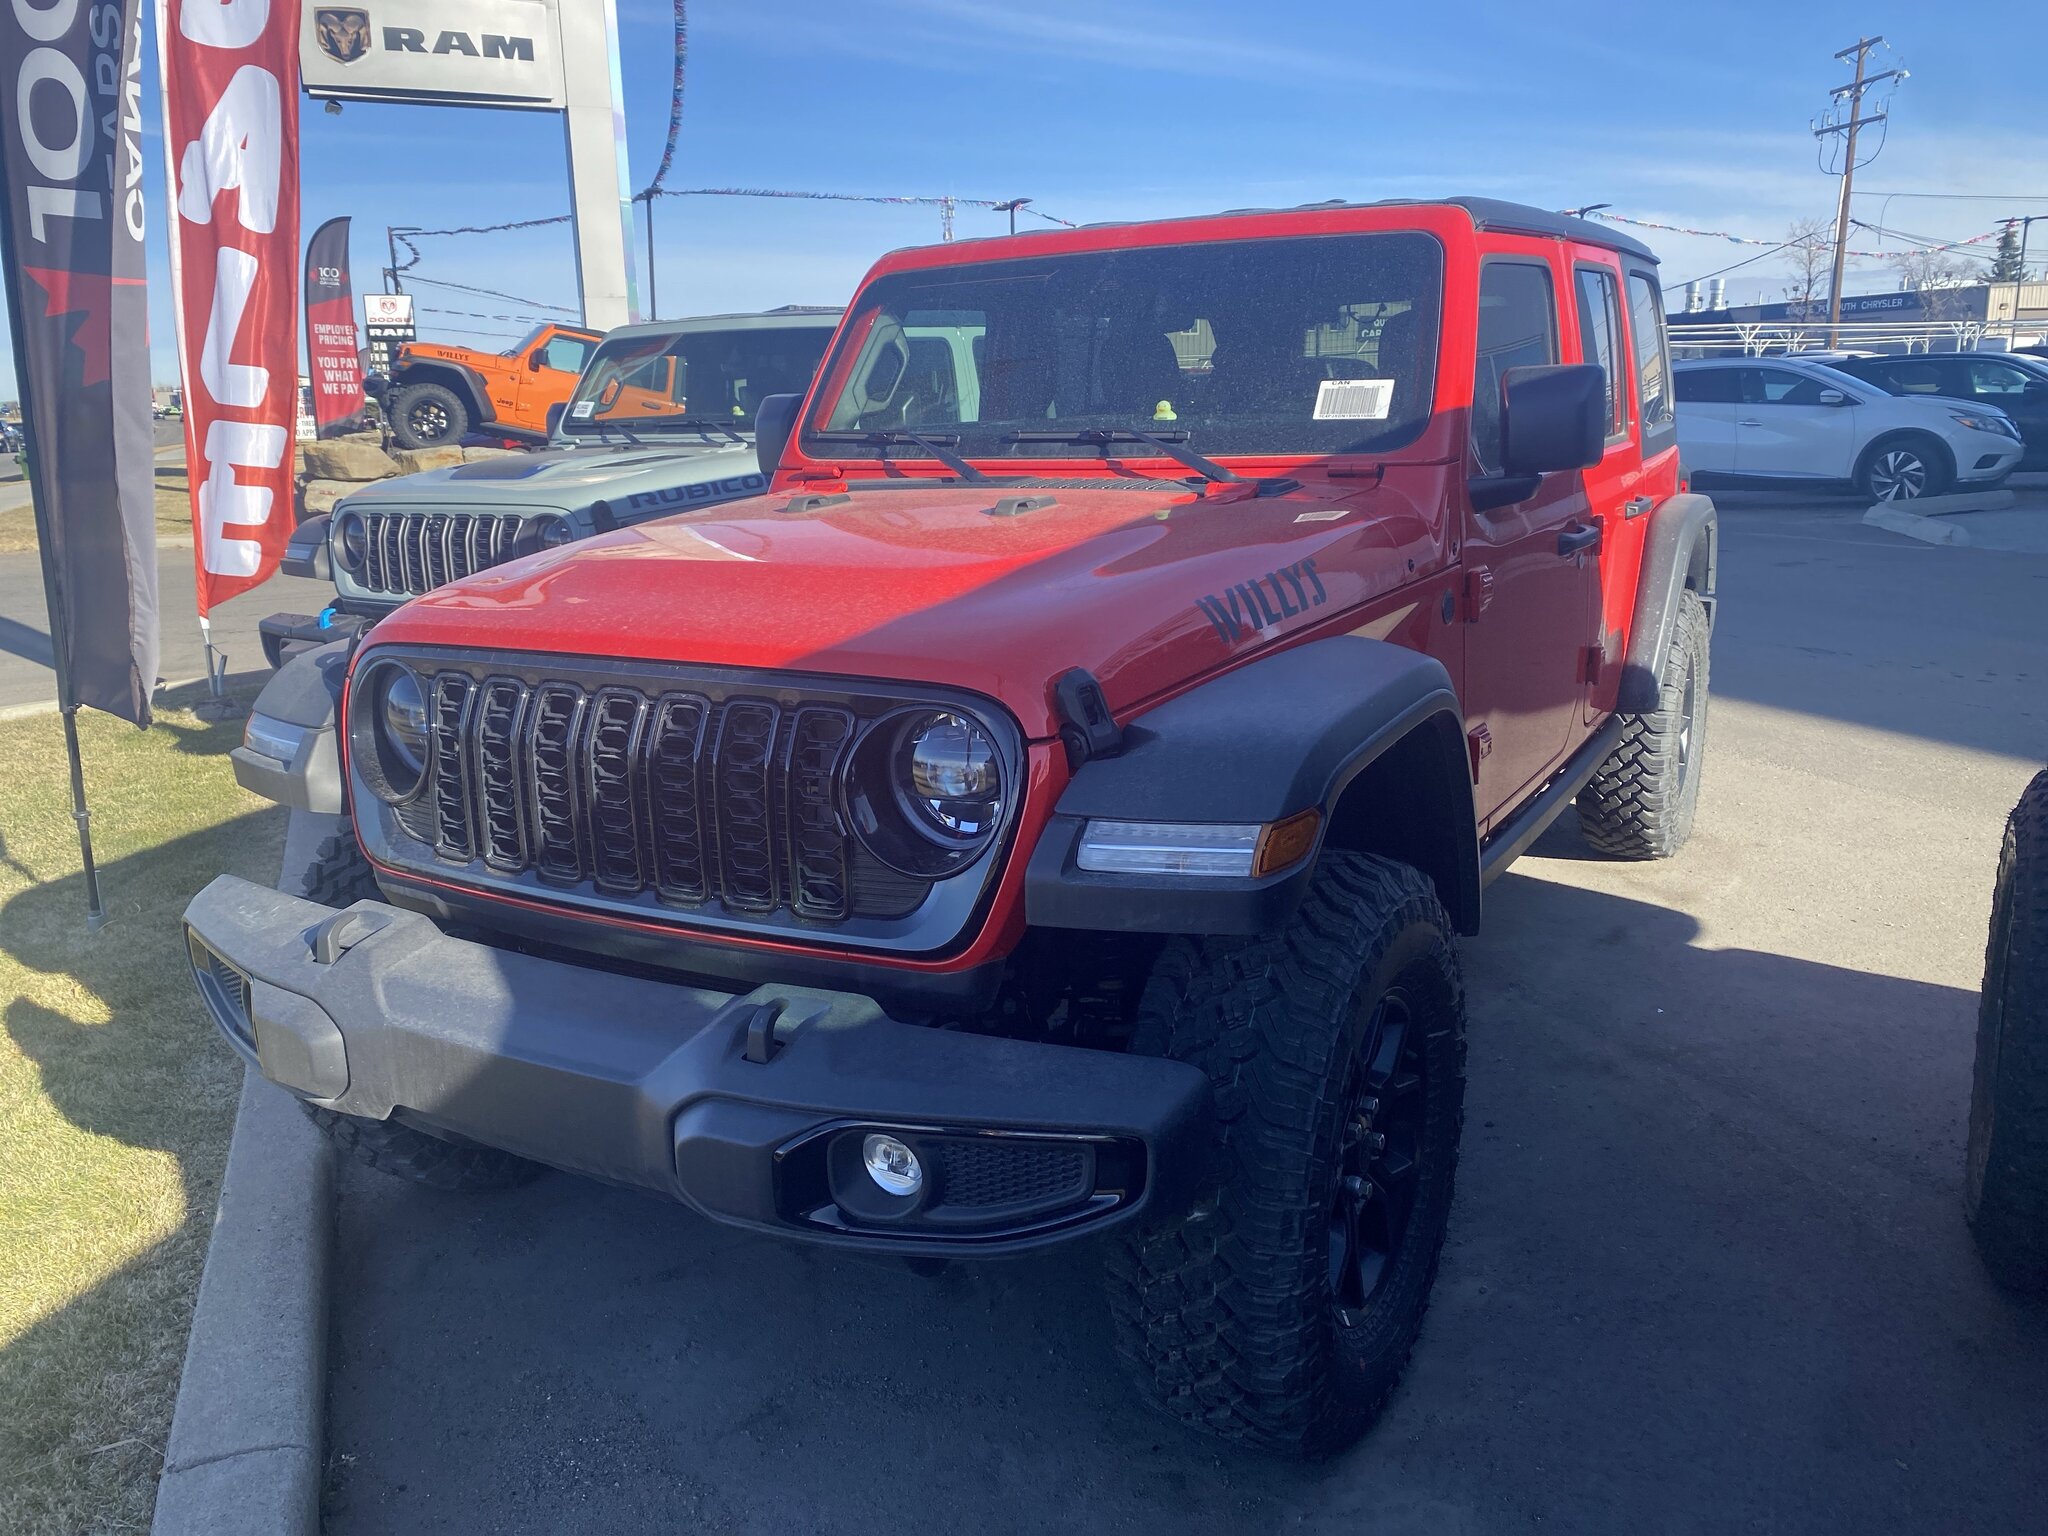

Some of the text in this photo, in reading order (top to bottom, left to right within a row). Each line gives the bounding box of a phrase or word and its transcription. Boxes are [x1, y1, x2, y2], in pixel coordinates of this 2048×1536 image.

[382, 26, 535, 62] RAM
[318, 267, 340, 278] 100
[1861, 298, 1903, 310] CHRYSLER
[314, 323, 354, 335] EMPLOYEE
[369, 328, 415, 337] RAM
[318, 335, 354, 346] PRICING
[437, 350, 470, 361] WILLYS
[317, 356, 358, 369] YOU PAY
[323, 370, 354, 382] WHAT
[322, 383, 359, 395] WE PAY
[496, 398, 514, 407] Jeep
[626, 473, 770, 509] RUBICO
[1194, 558, 1327, 644] WILLYS
